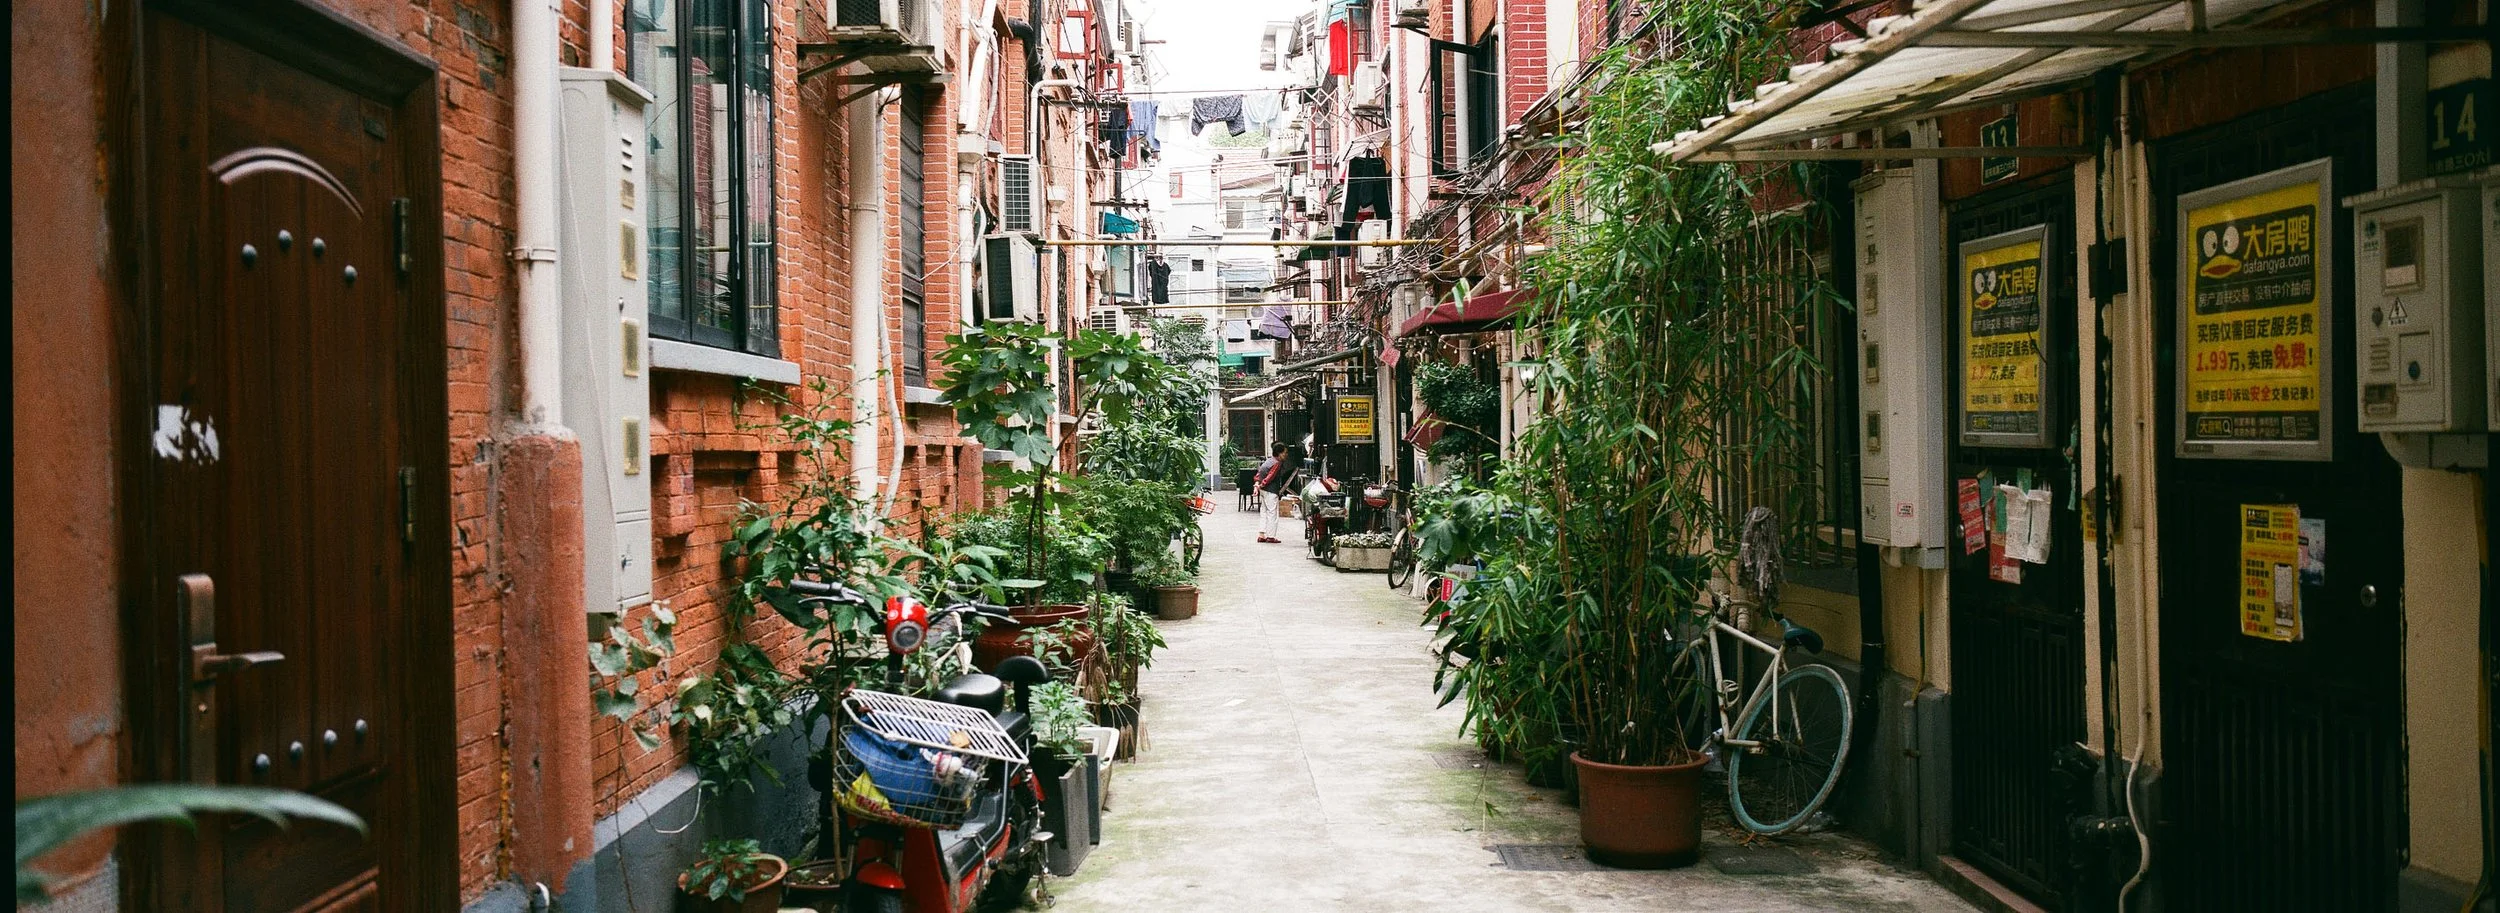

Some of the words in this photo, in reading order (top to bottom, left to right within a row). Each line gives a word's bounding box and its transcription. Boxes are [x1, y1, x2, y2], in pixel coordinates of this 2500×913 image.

[2432, 92, 2477, 151] 14
[2243, 214, 2310, 260] 大房鸭
[2243, 253, 2310, 275] dafangya.com
[2198, 313, 2314, 343] 买房仅需固定服务费
